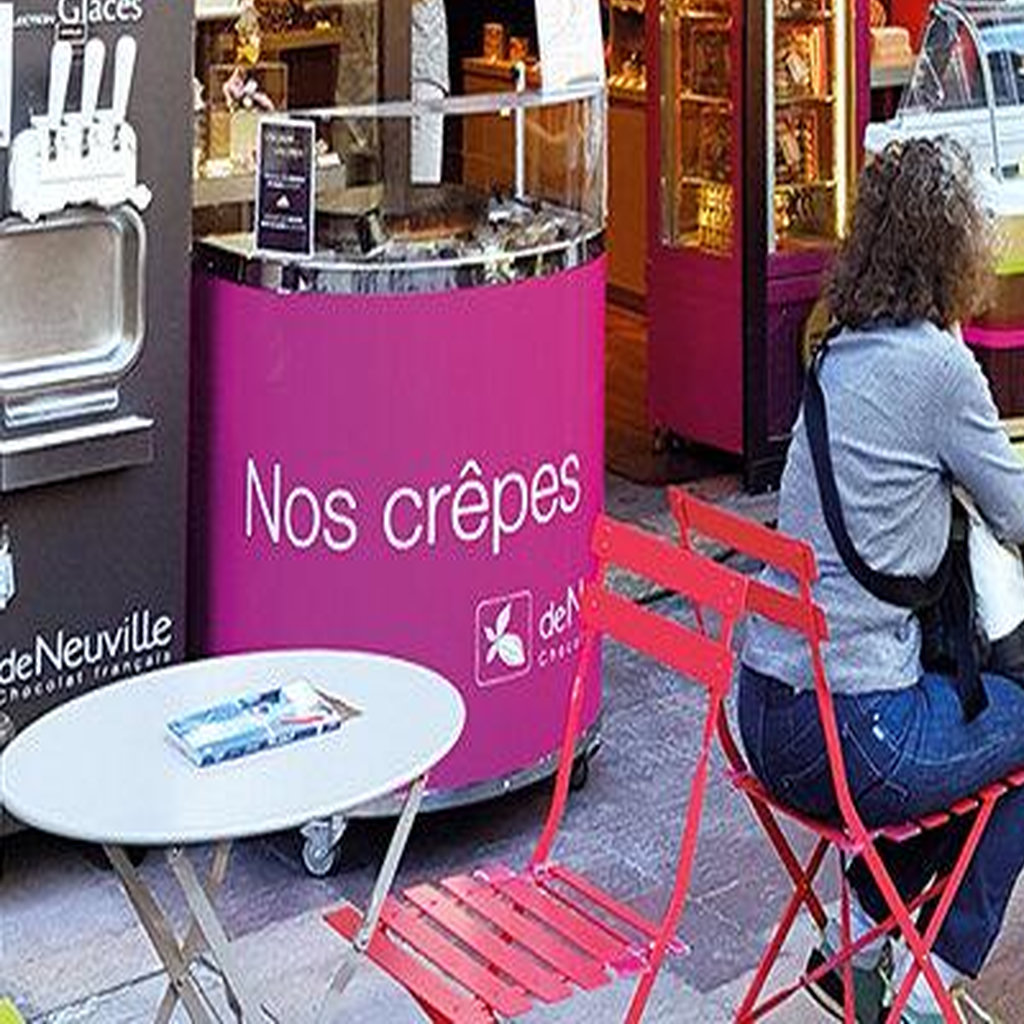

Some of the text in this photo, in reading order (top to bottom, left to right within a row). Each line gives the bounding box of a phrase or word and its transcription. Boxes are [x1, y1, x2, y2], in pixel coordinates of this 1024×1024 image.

[246, 453, 581, 556] Nos crêpes
[0, 609, 173, 685] deNeuville
